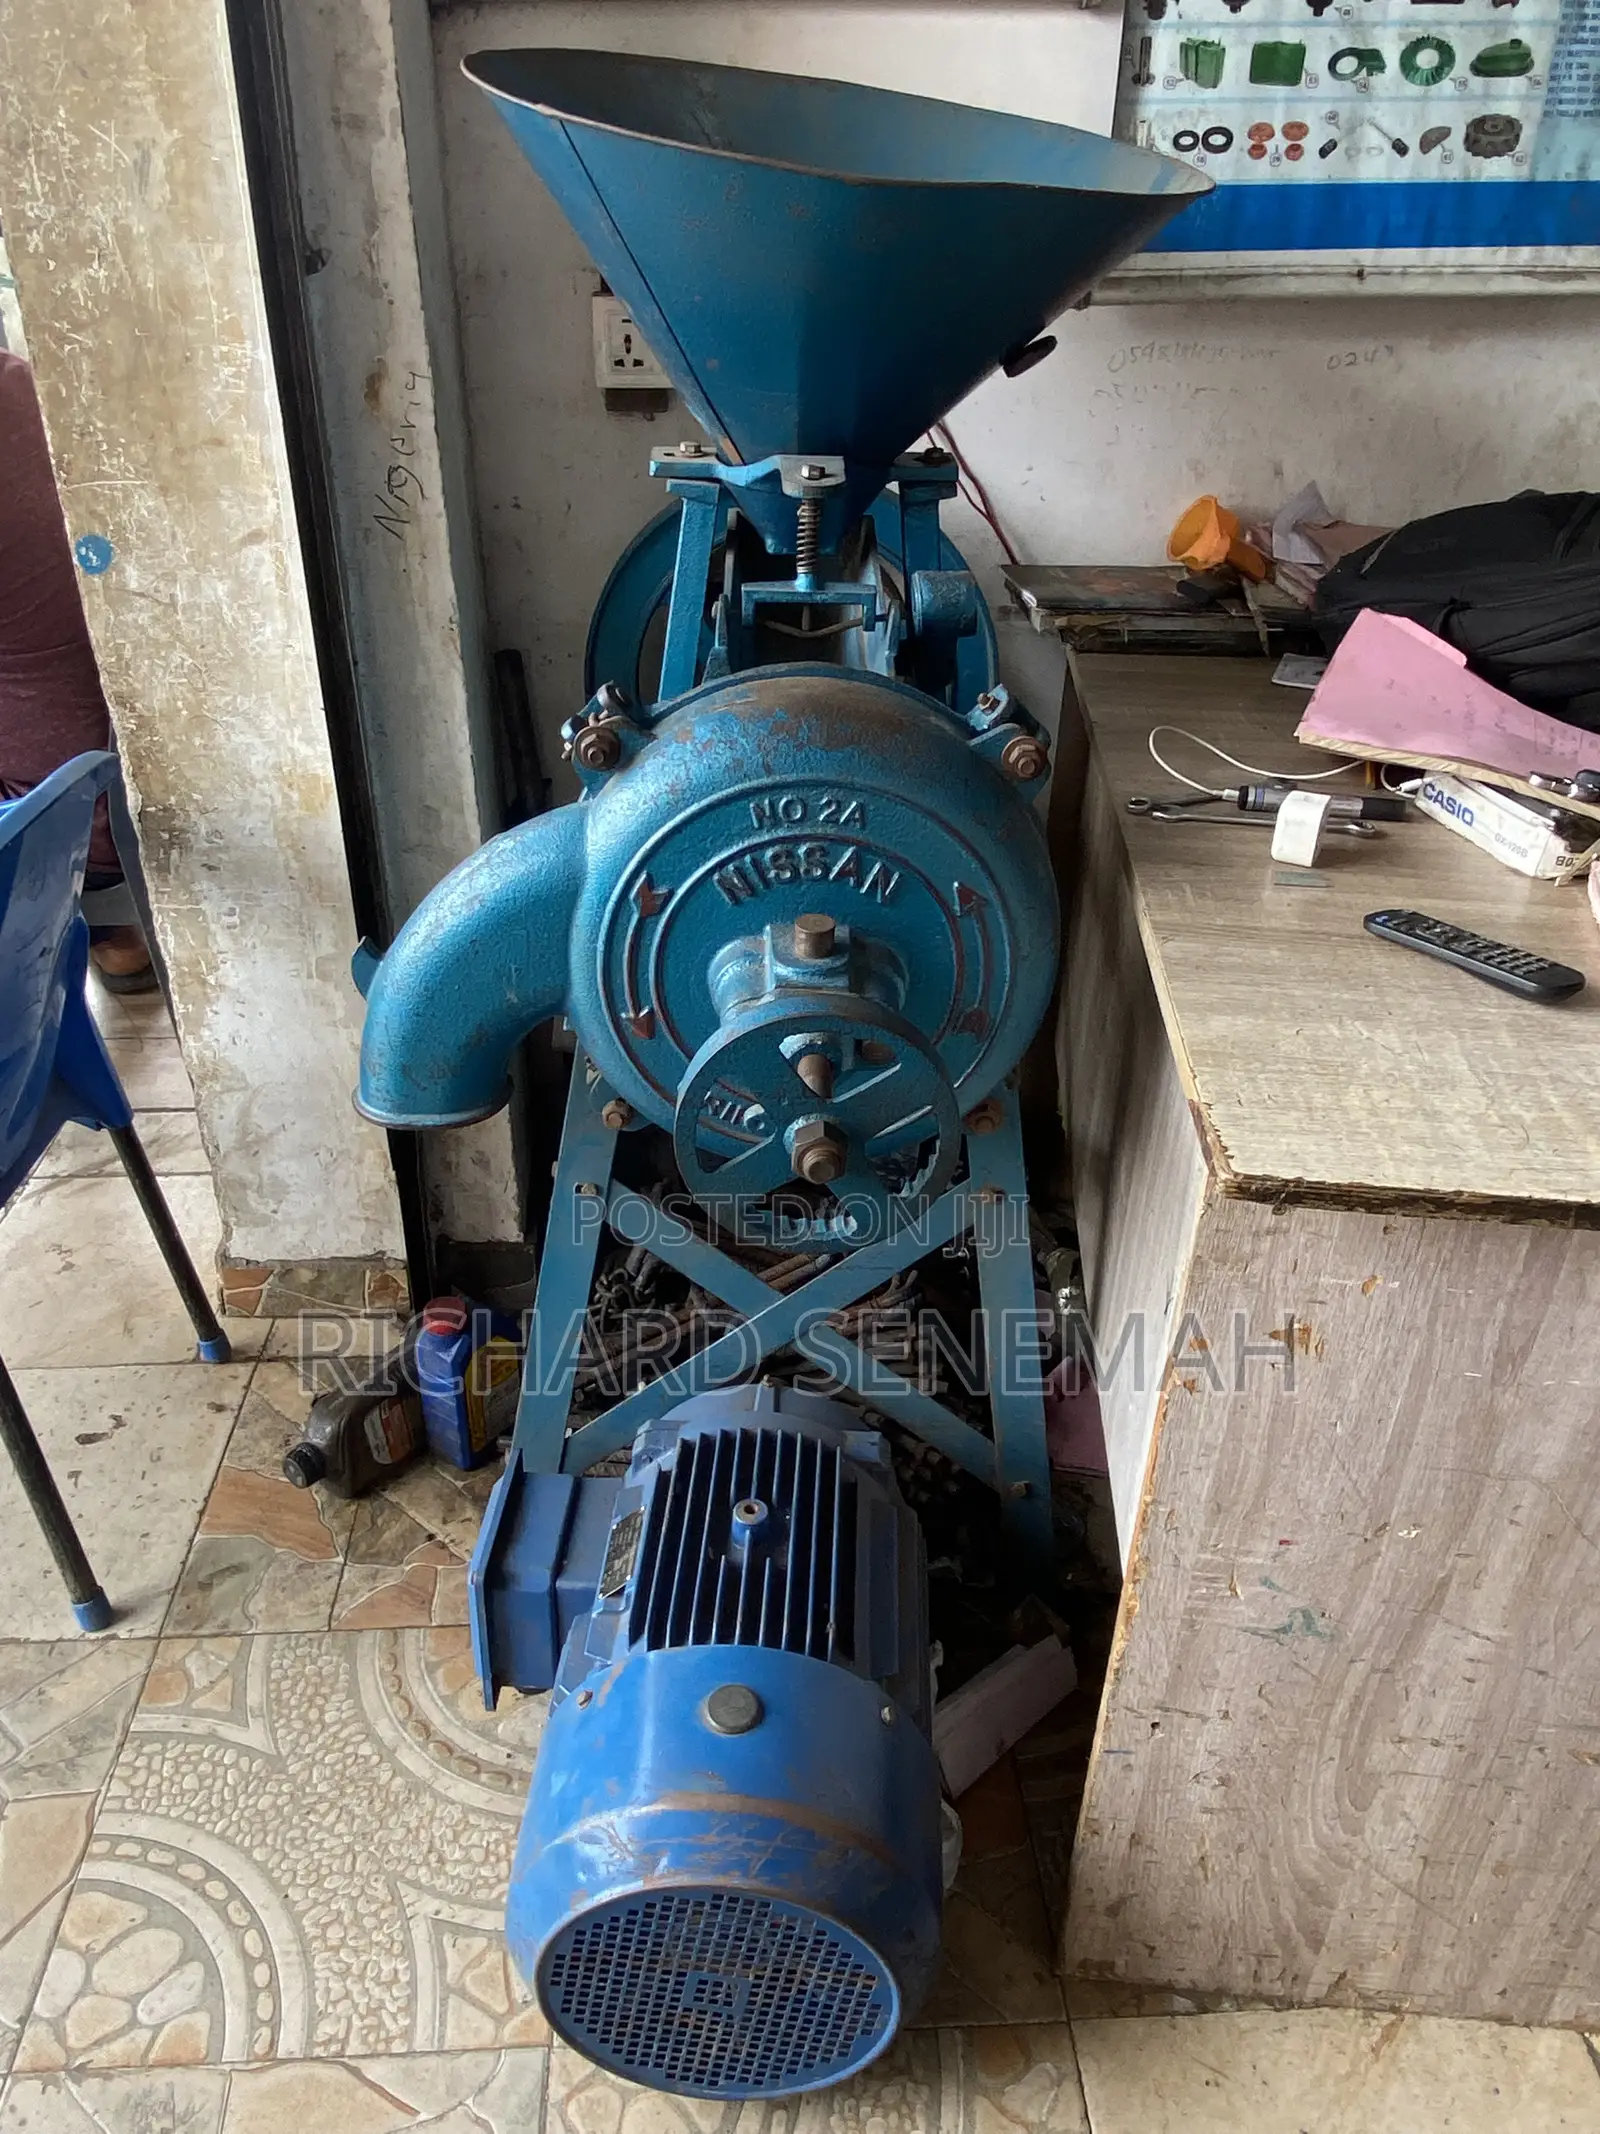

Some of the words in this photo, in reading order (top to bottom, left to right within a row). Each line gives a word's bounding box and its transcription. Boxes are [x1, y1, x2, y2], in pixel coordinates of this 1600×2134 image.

[750, 795, 807, 829] NO
[819, 795, 866, 830] 2A
[1422, 783, 1475, 827] CASIO
[713, 841, 900, 906] NISSAN
